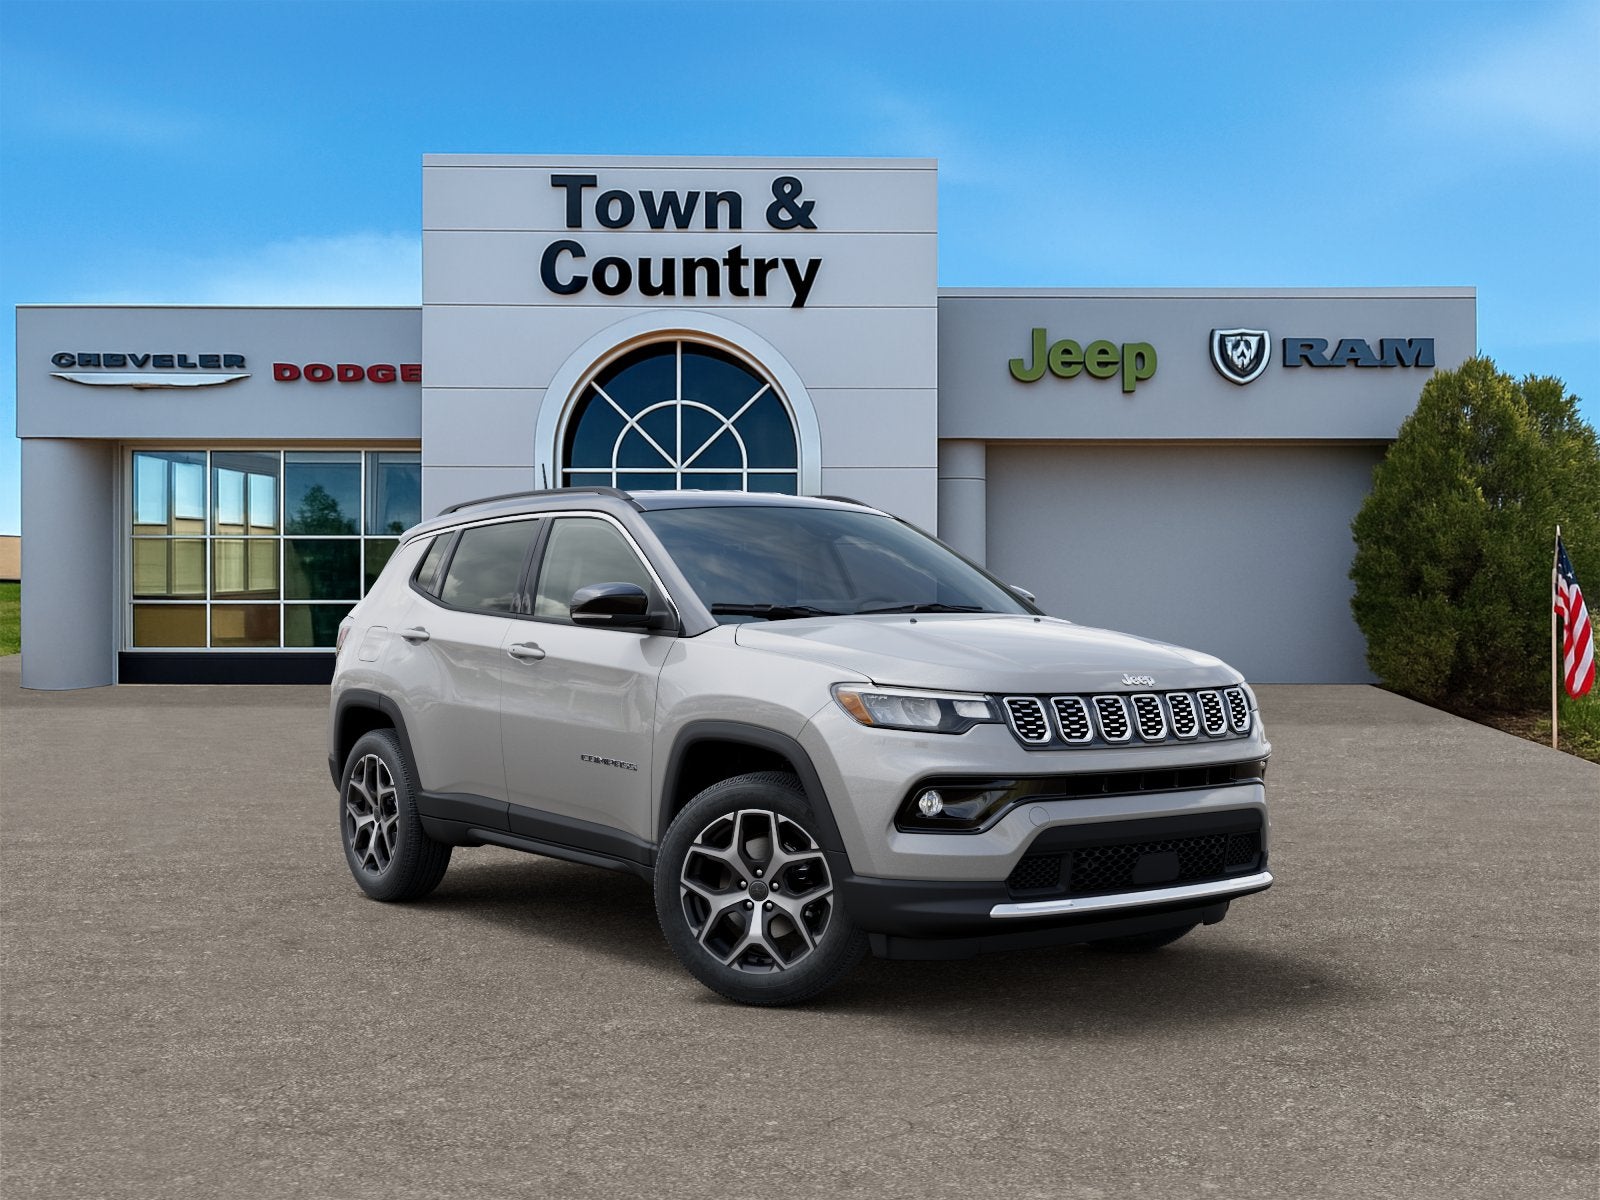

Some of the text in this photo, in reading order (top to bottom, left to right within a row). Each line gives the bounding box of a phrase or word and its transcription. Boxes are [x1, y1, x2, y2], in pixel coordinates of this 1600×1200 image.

[551, 174, 818, 229] Town &
[540, 239, 822, 308] Country
[273, 362, 422, 383] DODGE
[1008, 327, 1157, 393] Jeep
[1282, 337, 1435, 368] RAM
[1121, 673, 1156, 687] Jeep
